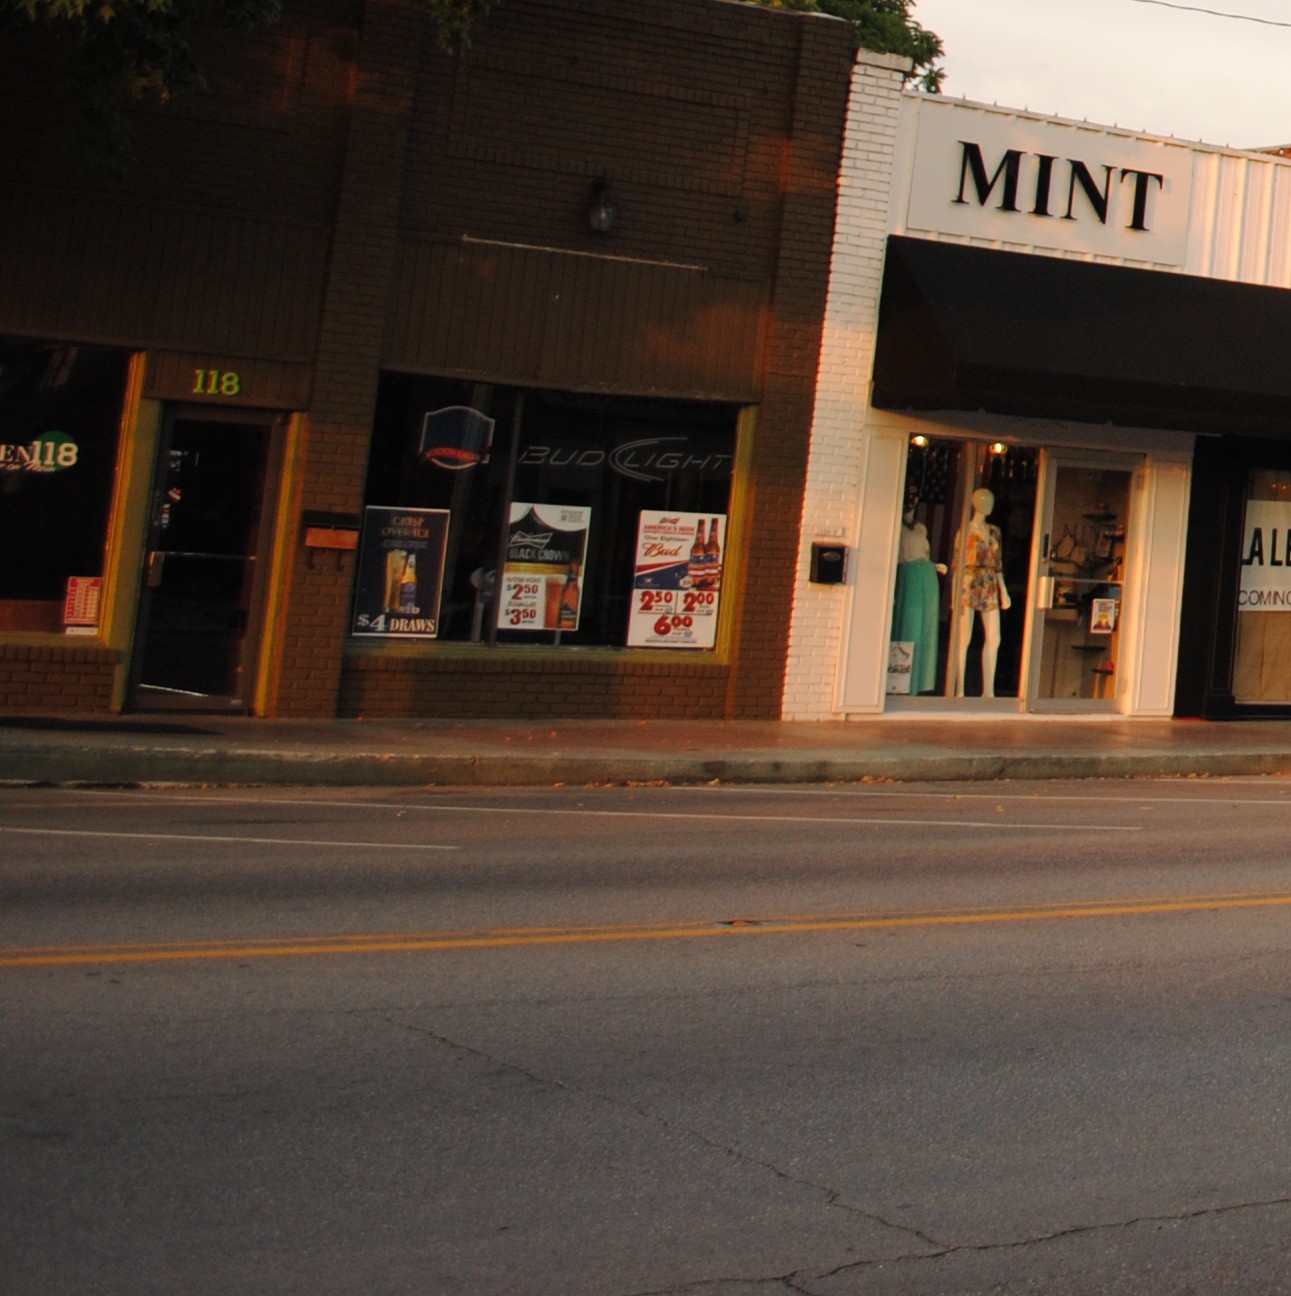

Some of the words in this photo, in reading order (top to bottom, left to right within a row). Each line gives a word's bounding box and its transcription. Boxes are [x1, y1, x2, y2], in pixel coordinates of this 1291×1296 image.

[951, 140, 1163, 231] MINT
[192, 369, 241, 396] 118
[518, 446, 606, 466] BUD
[622, 452, 731, 470] LIGHT
[508, 547, 536, 560] BLACK
[642, 542, 683, 557] Bud
[358, 613, 386, 632] $4
[389, 618, 436, 632] DRAWS
